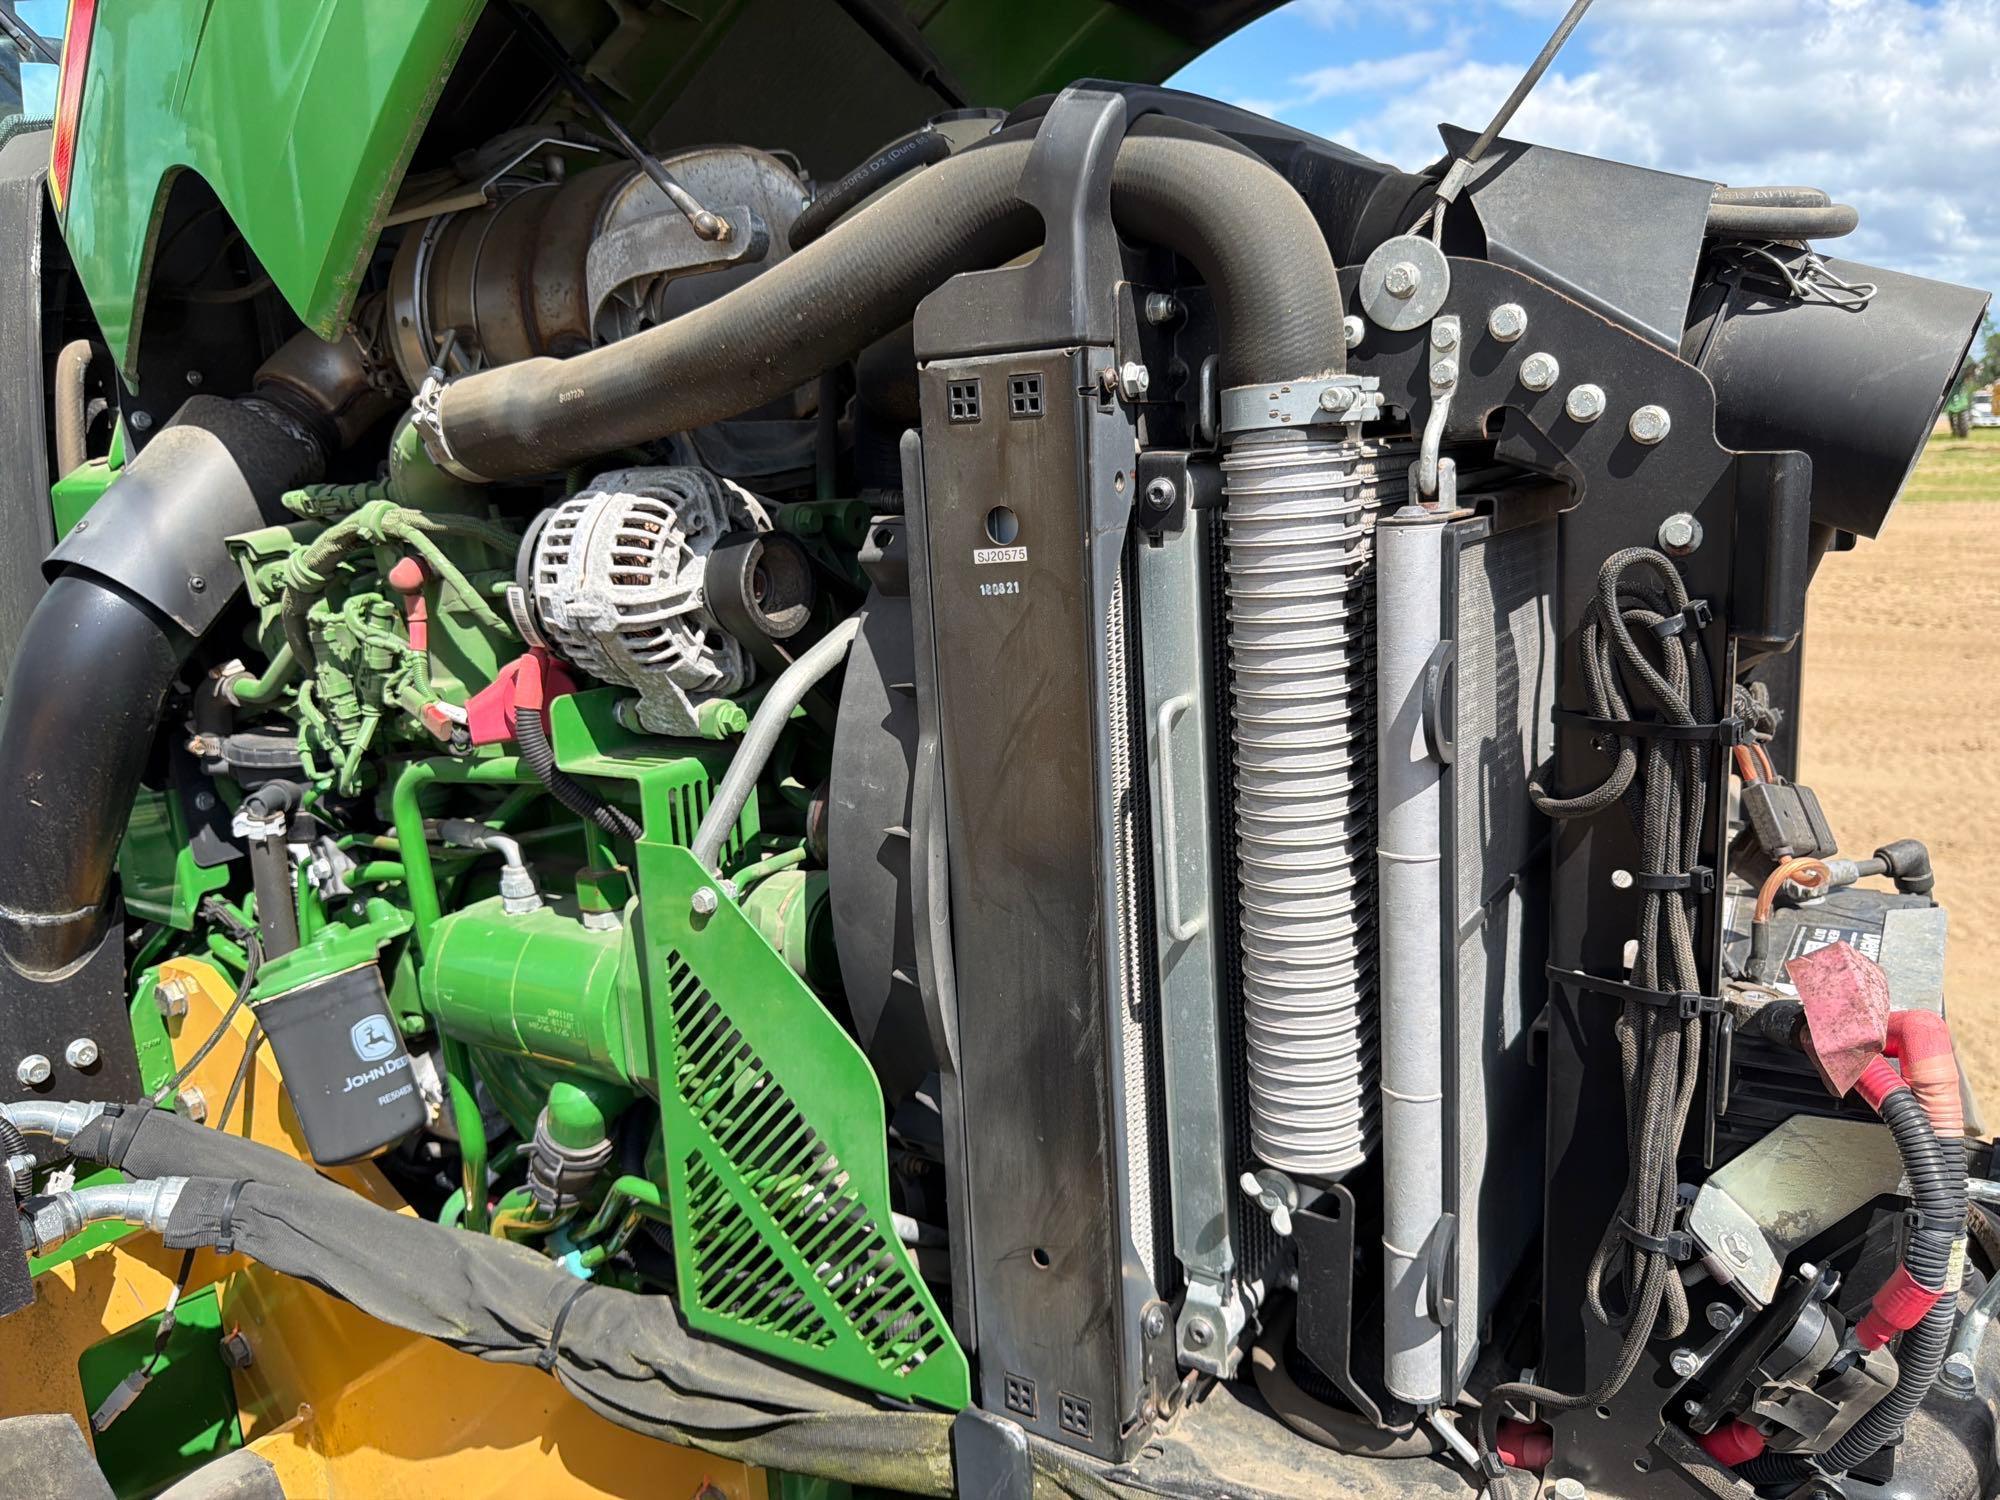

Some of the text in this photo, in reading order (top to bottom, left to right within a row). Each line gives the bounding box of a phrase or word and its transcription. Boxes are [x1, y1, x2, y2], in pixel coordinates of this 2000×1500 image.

[977, 549, 1025, 562] SJ20575
[343, 1055, 410, 1093] JOHN DEE
